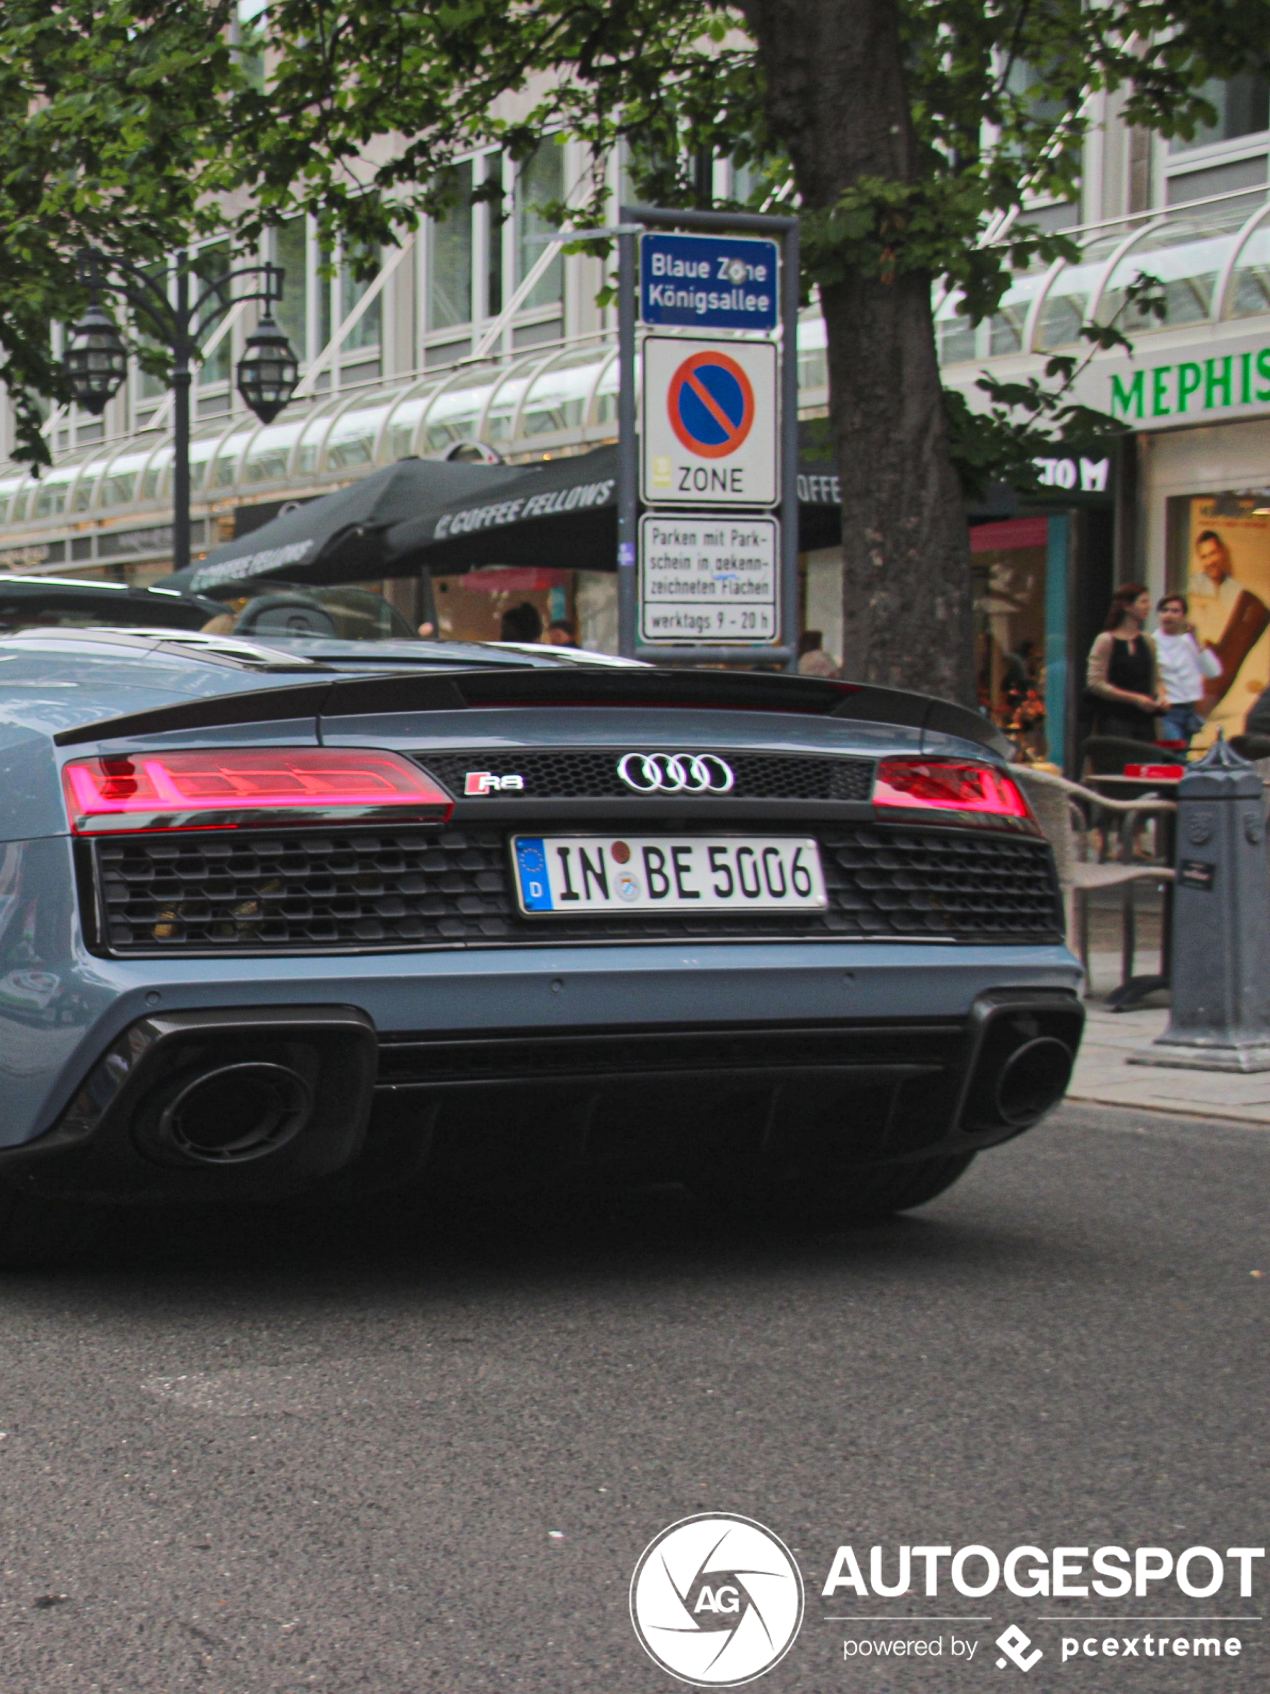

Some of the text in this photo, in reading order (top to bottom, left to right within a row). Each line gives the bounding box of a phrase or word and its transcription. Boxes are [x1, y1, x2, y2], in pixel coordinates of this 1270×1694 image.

[651, 252, 767, 282] Blaue Zne
[649, 283, 770, 315] Königsallee
[678, 466, 744, 492] ZONE
[449, 479, 616, 535] COFFEE FELLOWS
[652, 527, 768, 547] Parken mit Park-
[650, 552, 692, 570] schein
[697, 552, 709, 571] in
[650, 576, 716, 595] zeichneten
[651, 610, 711, 634] werktags
[717, 611, 725, 629] 9
[741, 611, 756, 629] 20
[760, 612, 768, 629] h
[556, 845, 812, 901] IN BE 5006
[530, 881, 543, 898] D
